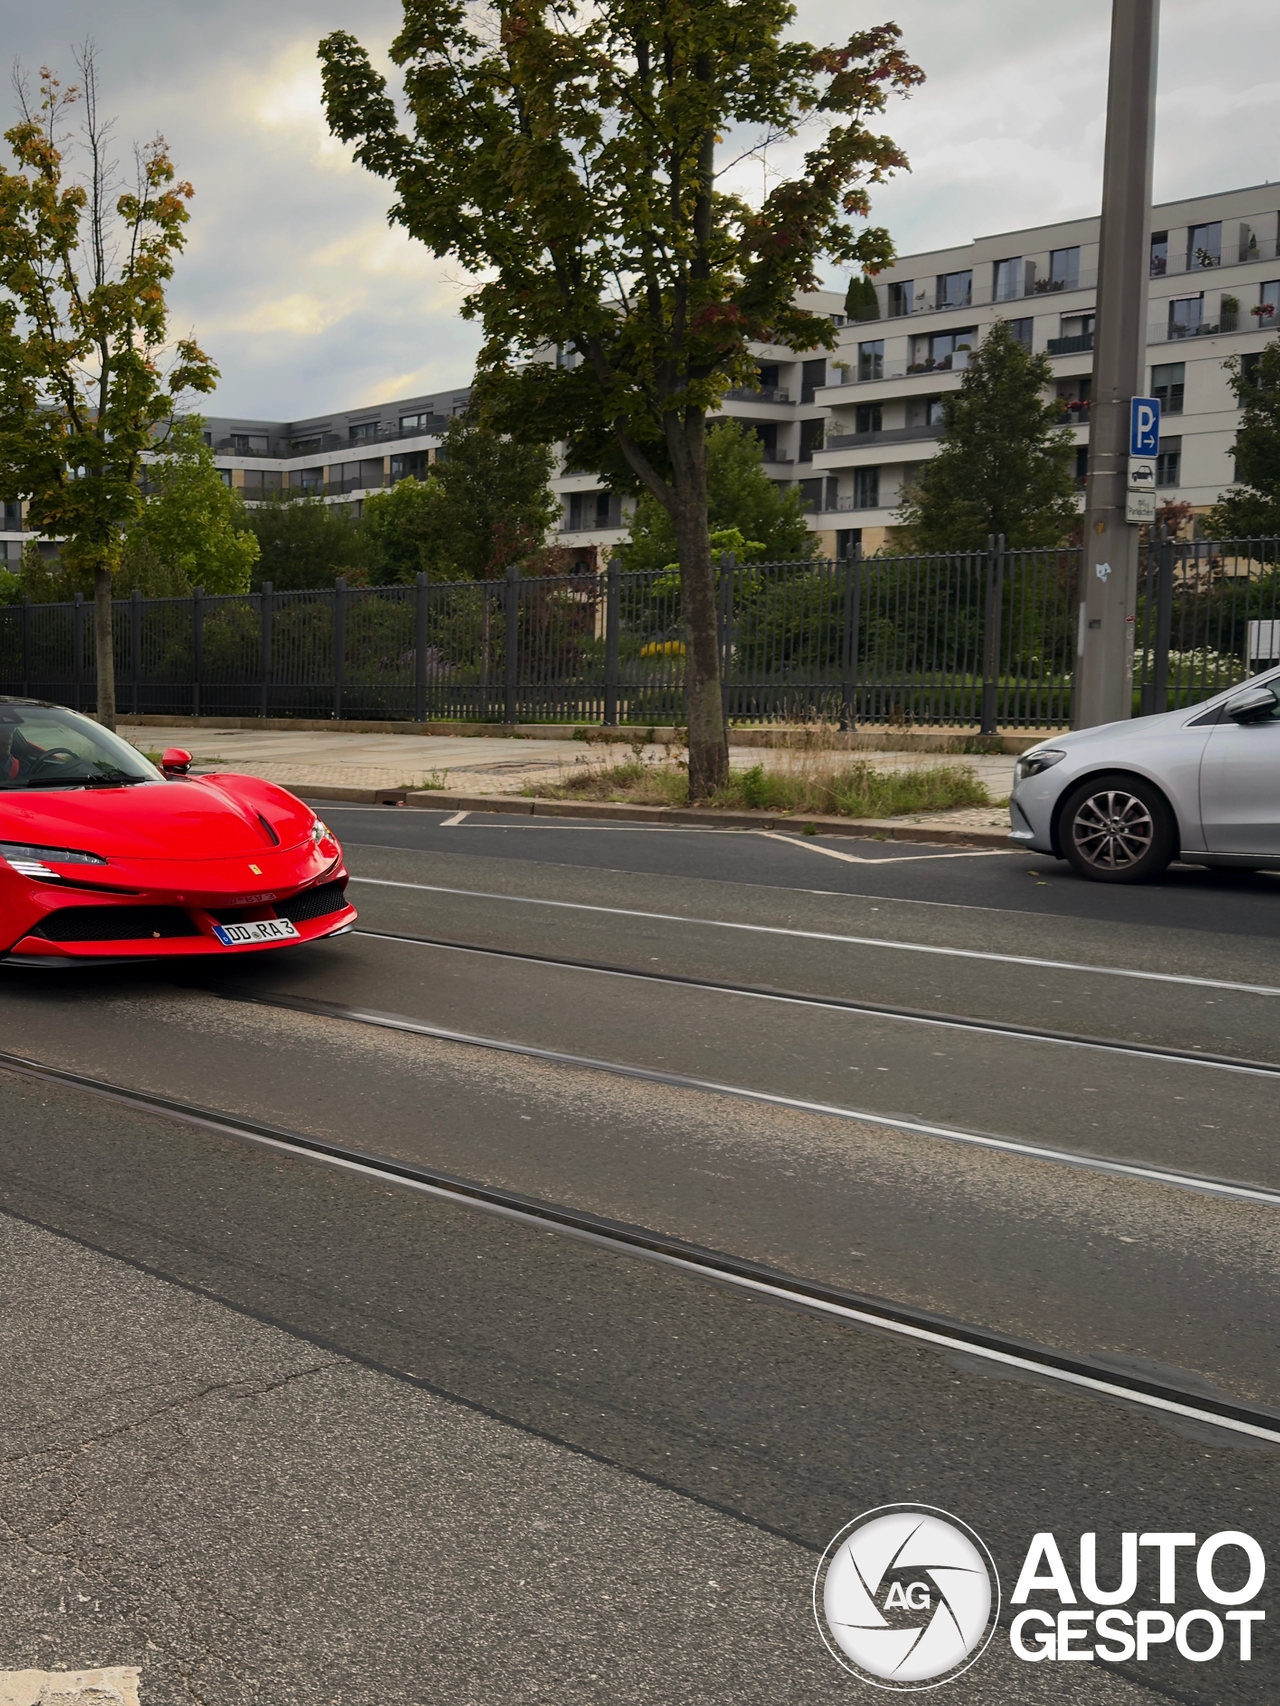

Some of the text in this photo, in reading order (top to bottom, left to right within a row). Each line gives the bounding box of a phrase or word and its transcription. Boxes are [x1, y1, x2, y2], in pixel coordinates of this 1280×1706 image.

[1137, 405, 1155, 448] P
[224, 926, 251, 941] DD
[256, 923, 283, 938] RA
[280, 921, 295, 934] 3
